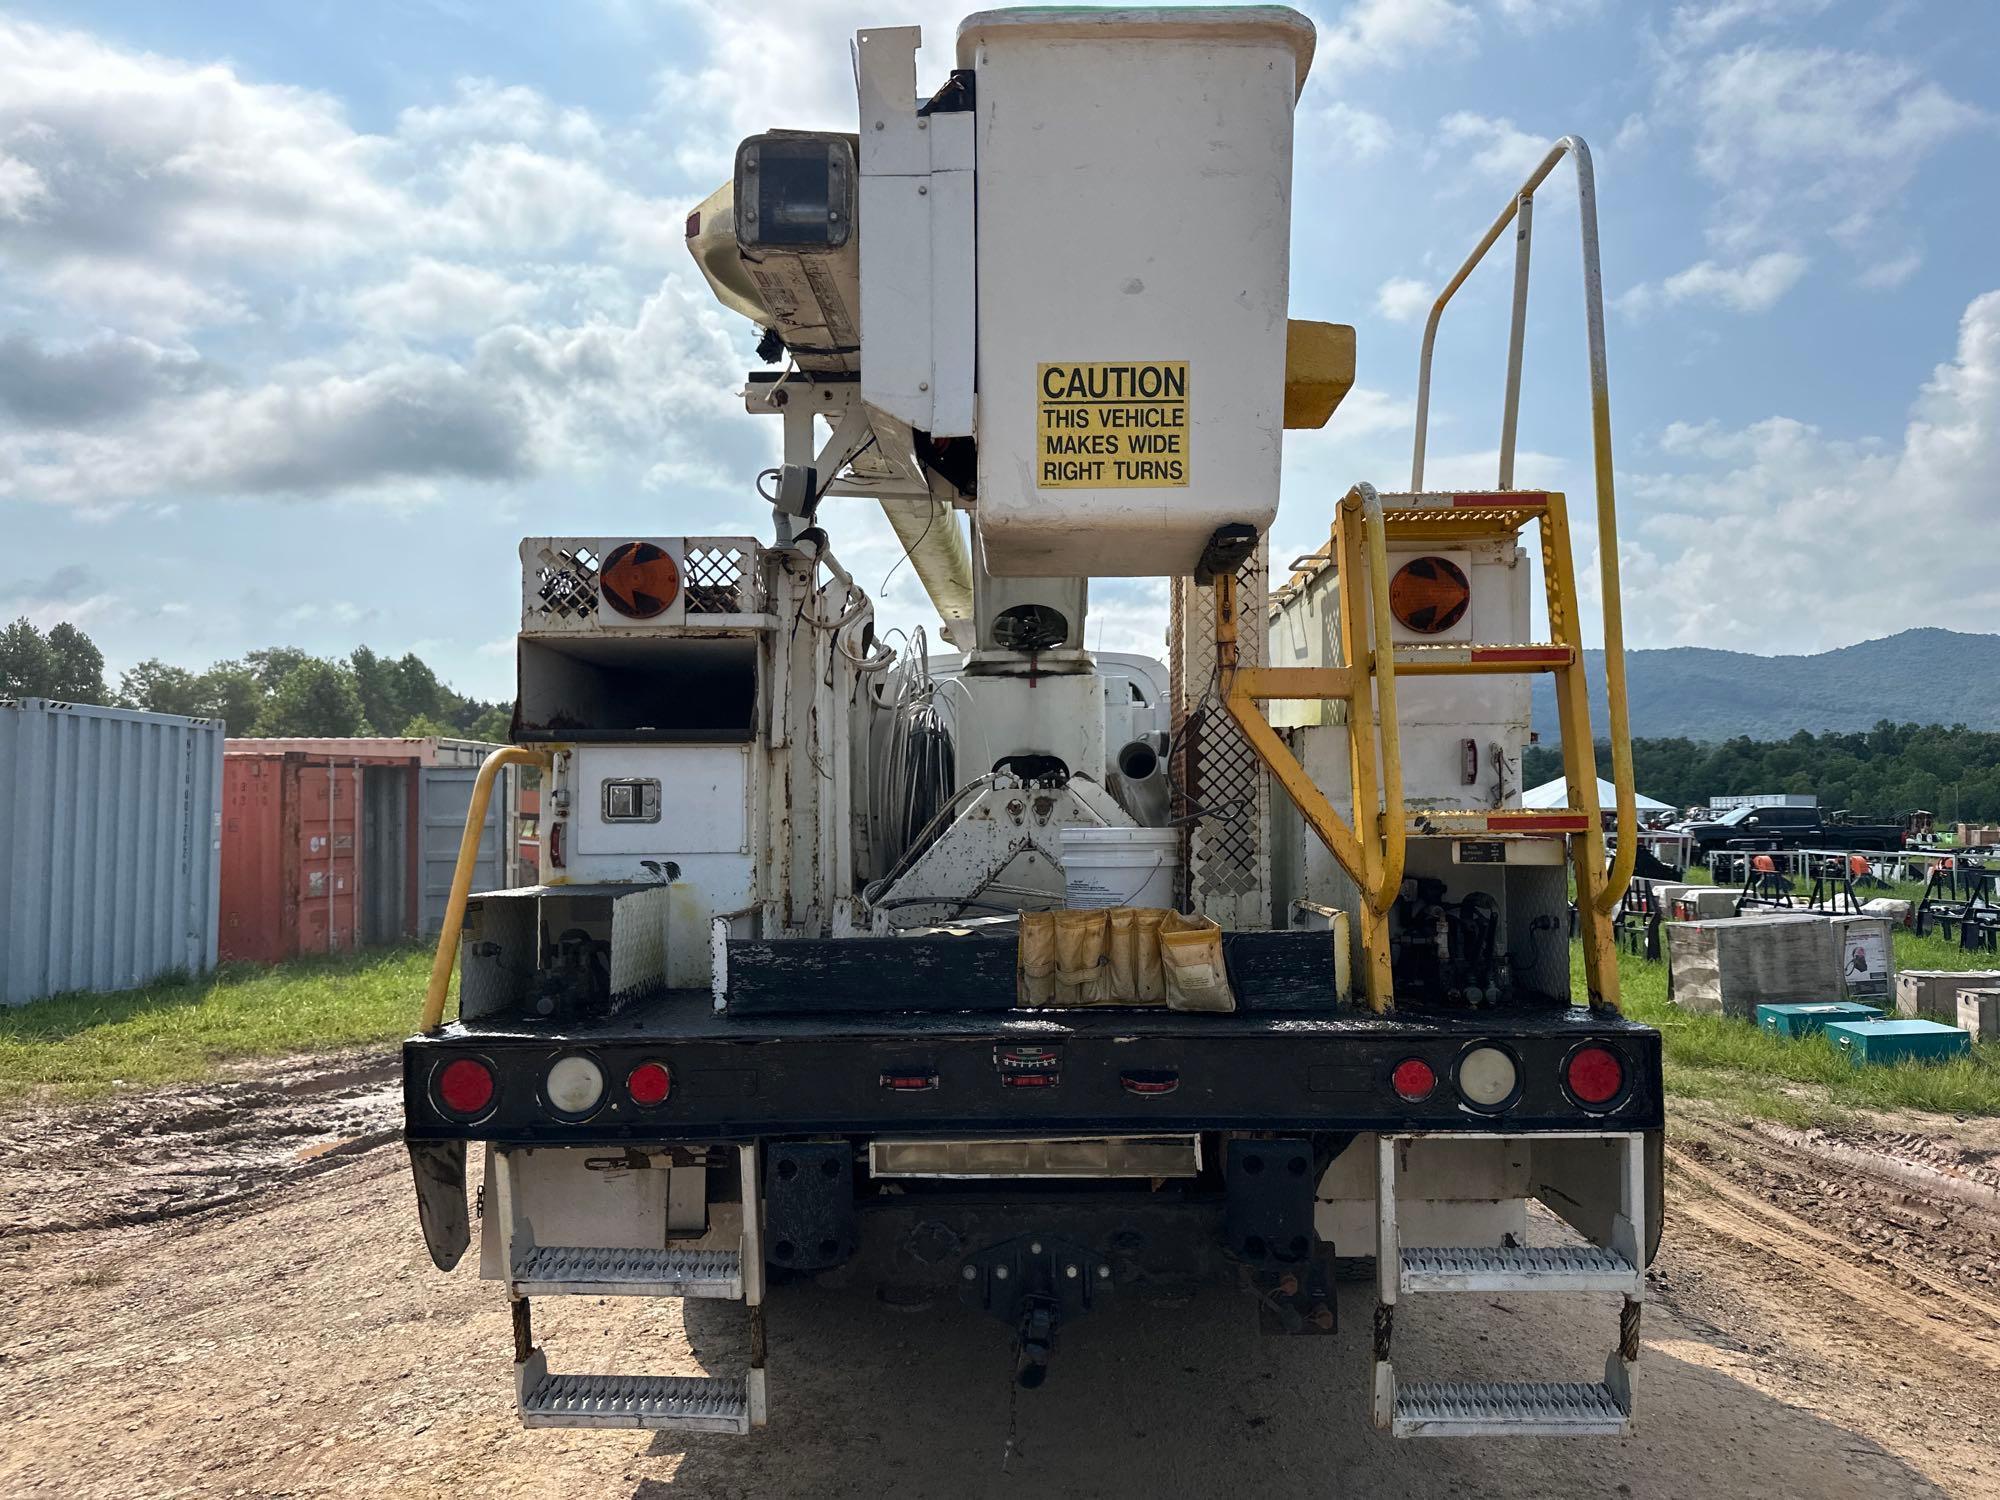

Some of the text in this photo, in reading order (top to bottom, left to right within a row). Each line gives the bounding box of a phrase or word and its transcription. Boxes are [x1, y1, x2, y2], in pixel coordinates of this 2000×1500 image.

[1043, 366, 1185, 398] CAUTION
[1043, 408, 1184, 428] THIS VEHICLE
[1046, 434, 1180, 454] MAKES WIDE
[1044, 460, 1183, 480] RIGHT TURNS
